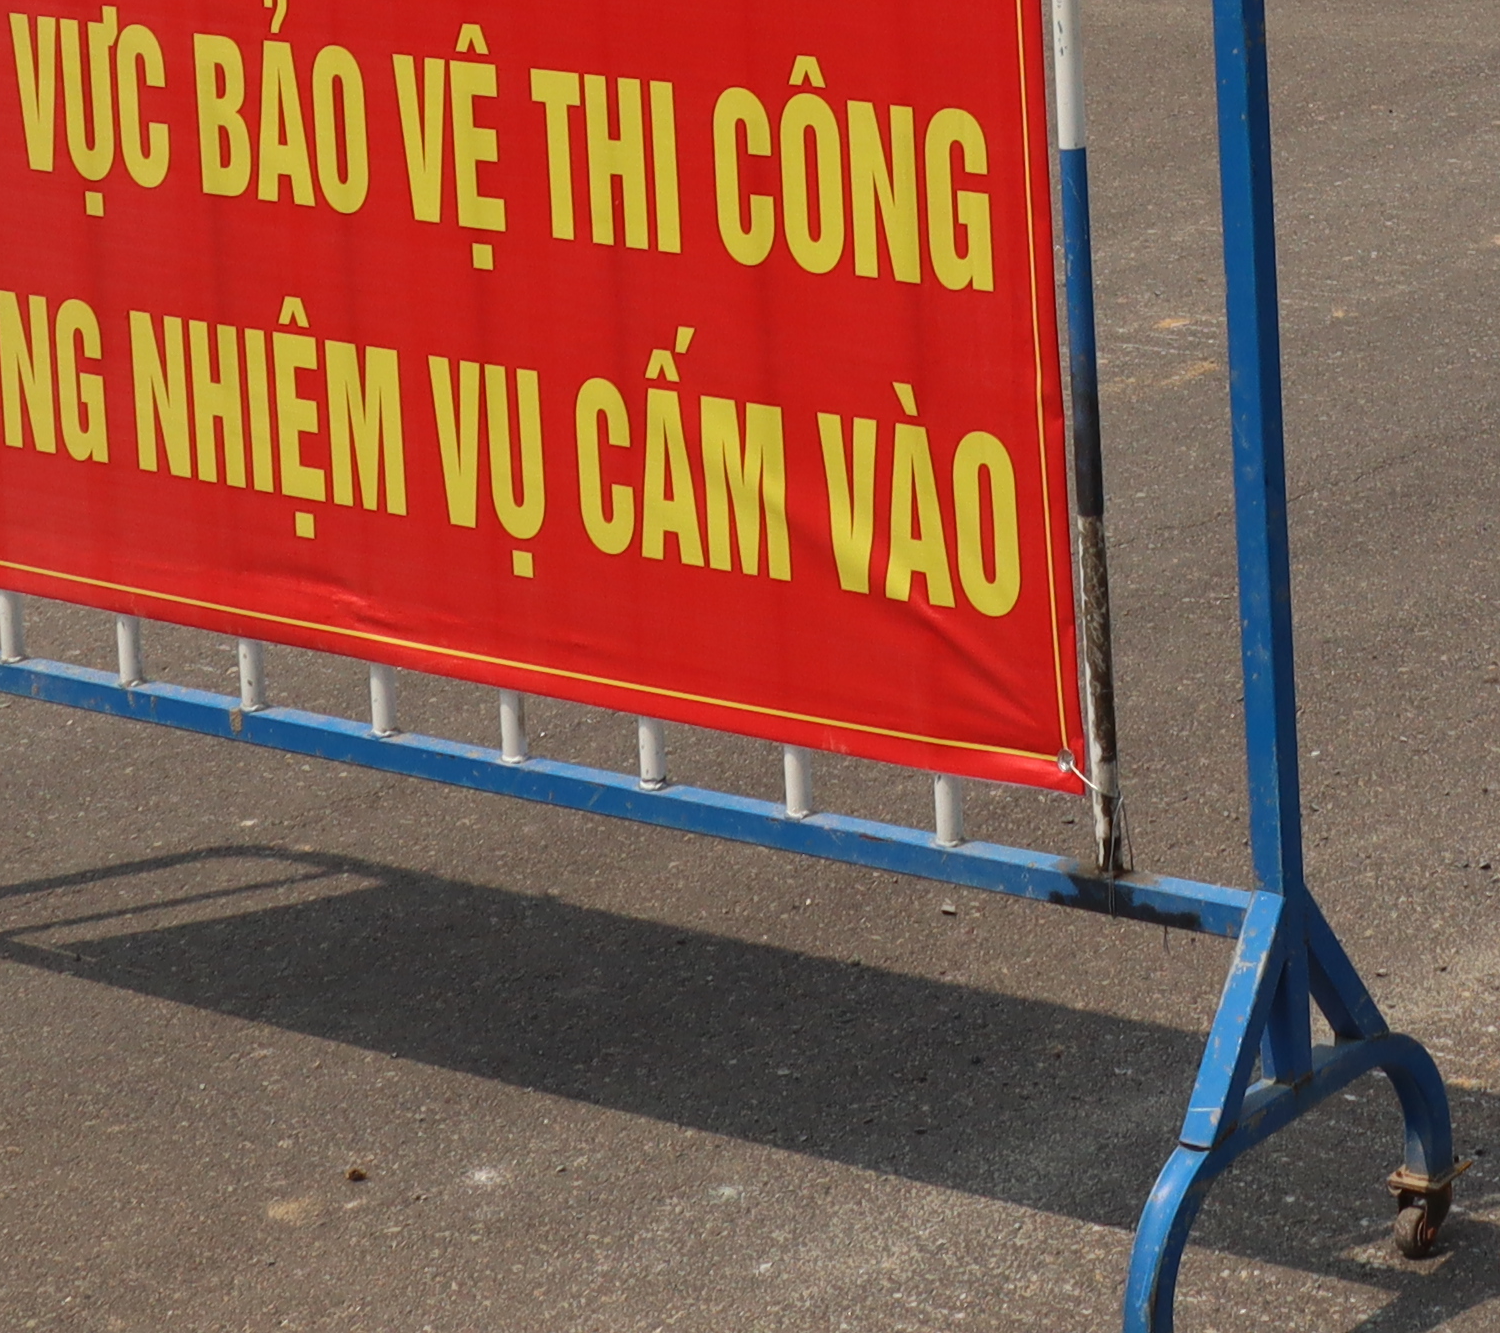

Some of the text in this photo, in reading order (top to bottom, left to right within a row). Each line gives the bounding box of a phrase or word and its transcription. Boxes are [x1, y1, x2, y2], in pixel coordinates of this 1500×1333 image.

[9, 4, 171, 218] VỰC
[392, 23, 507, 270] VỆ
[530, 67, 682, 255] THI
[712, 54, 995, 293] CÔNG
[129, 295, 408, 540] NHIỆM
[428, 354, 547, 579] VỤ
[574, 325, 793, 583] CẤM
[816, 381, 1022, 618] VÀO
